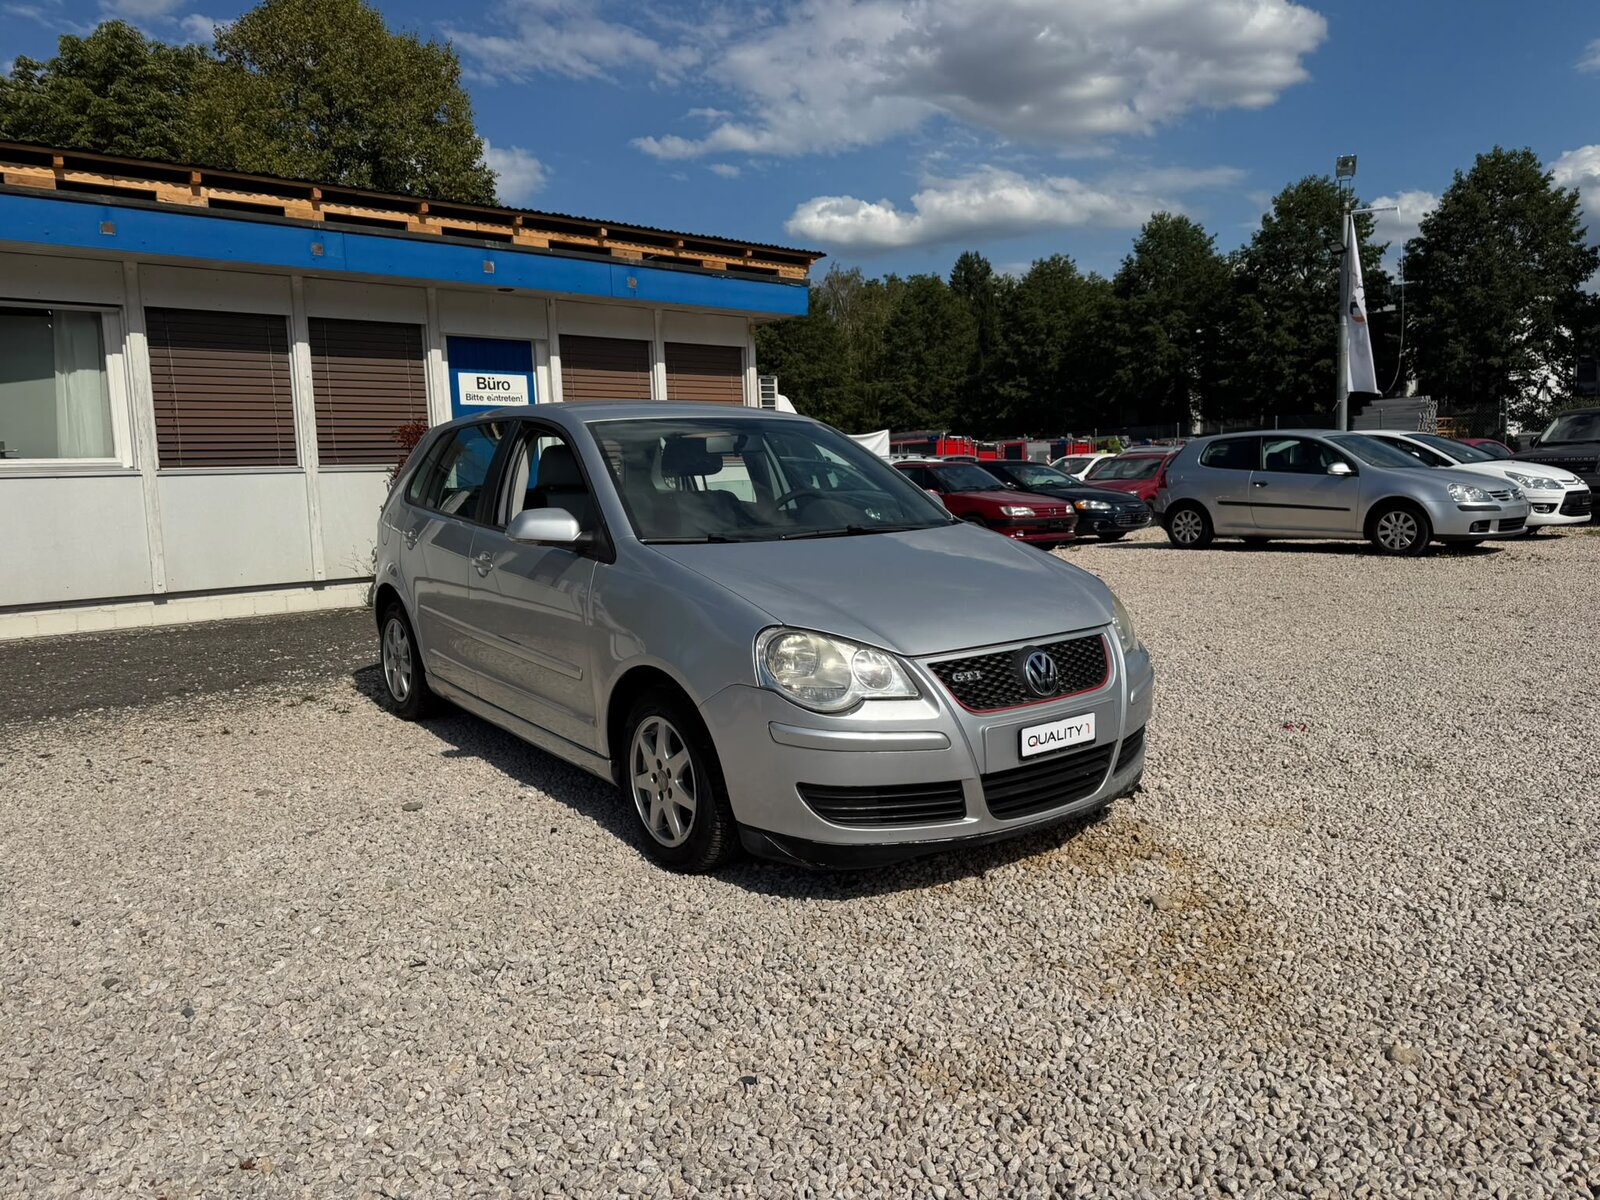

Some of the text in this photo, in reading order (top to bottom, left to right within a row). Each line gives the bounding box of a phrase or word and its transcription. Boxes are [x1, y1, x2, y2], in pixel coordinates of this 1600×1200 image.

[476, 376, 511, 391] Büro
[465, 393, 523, 402] Bitte eintreten!
[952, 670, 983, 682] GTI
[1027, 723, 1083, 747] QUALITY
